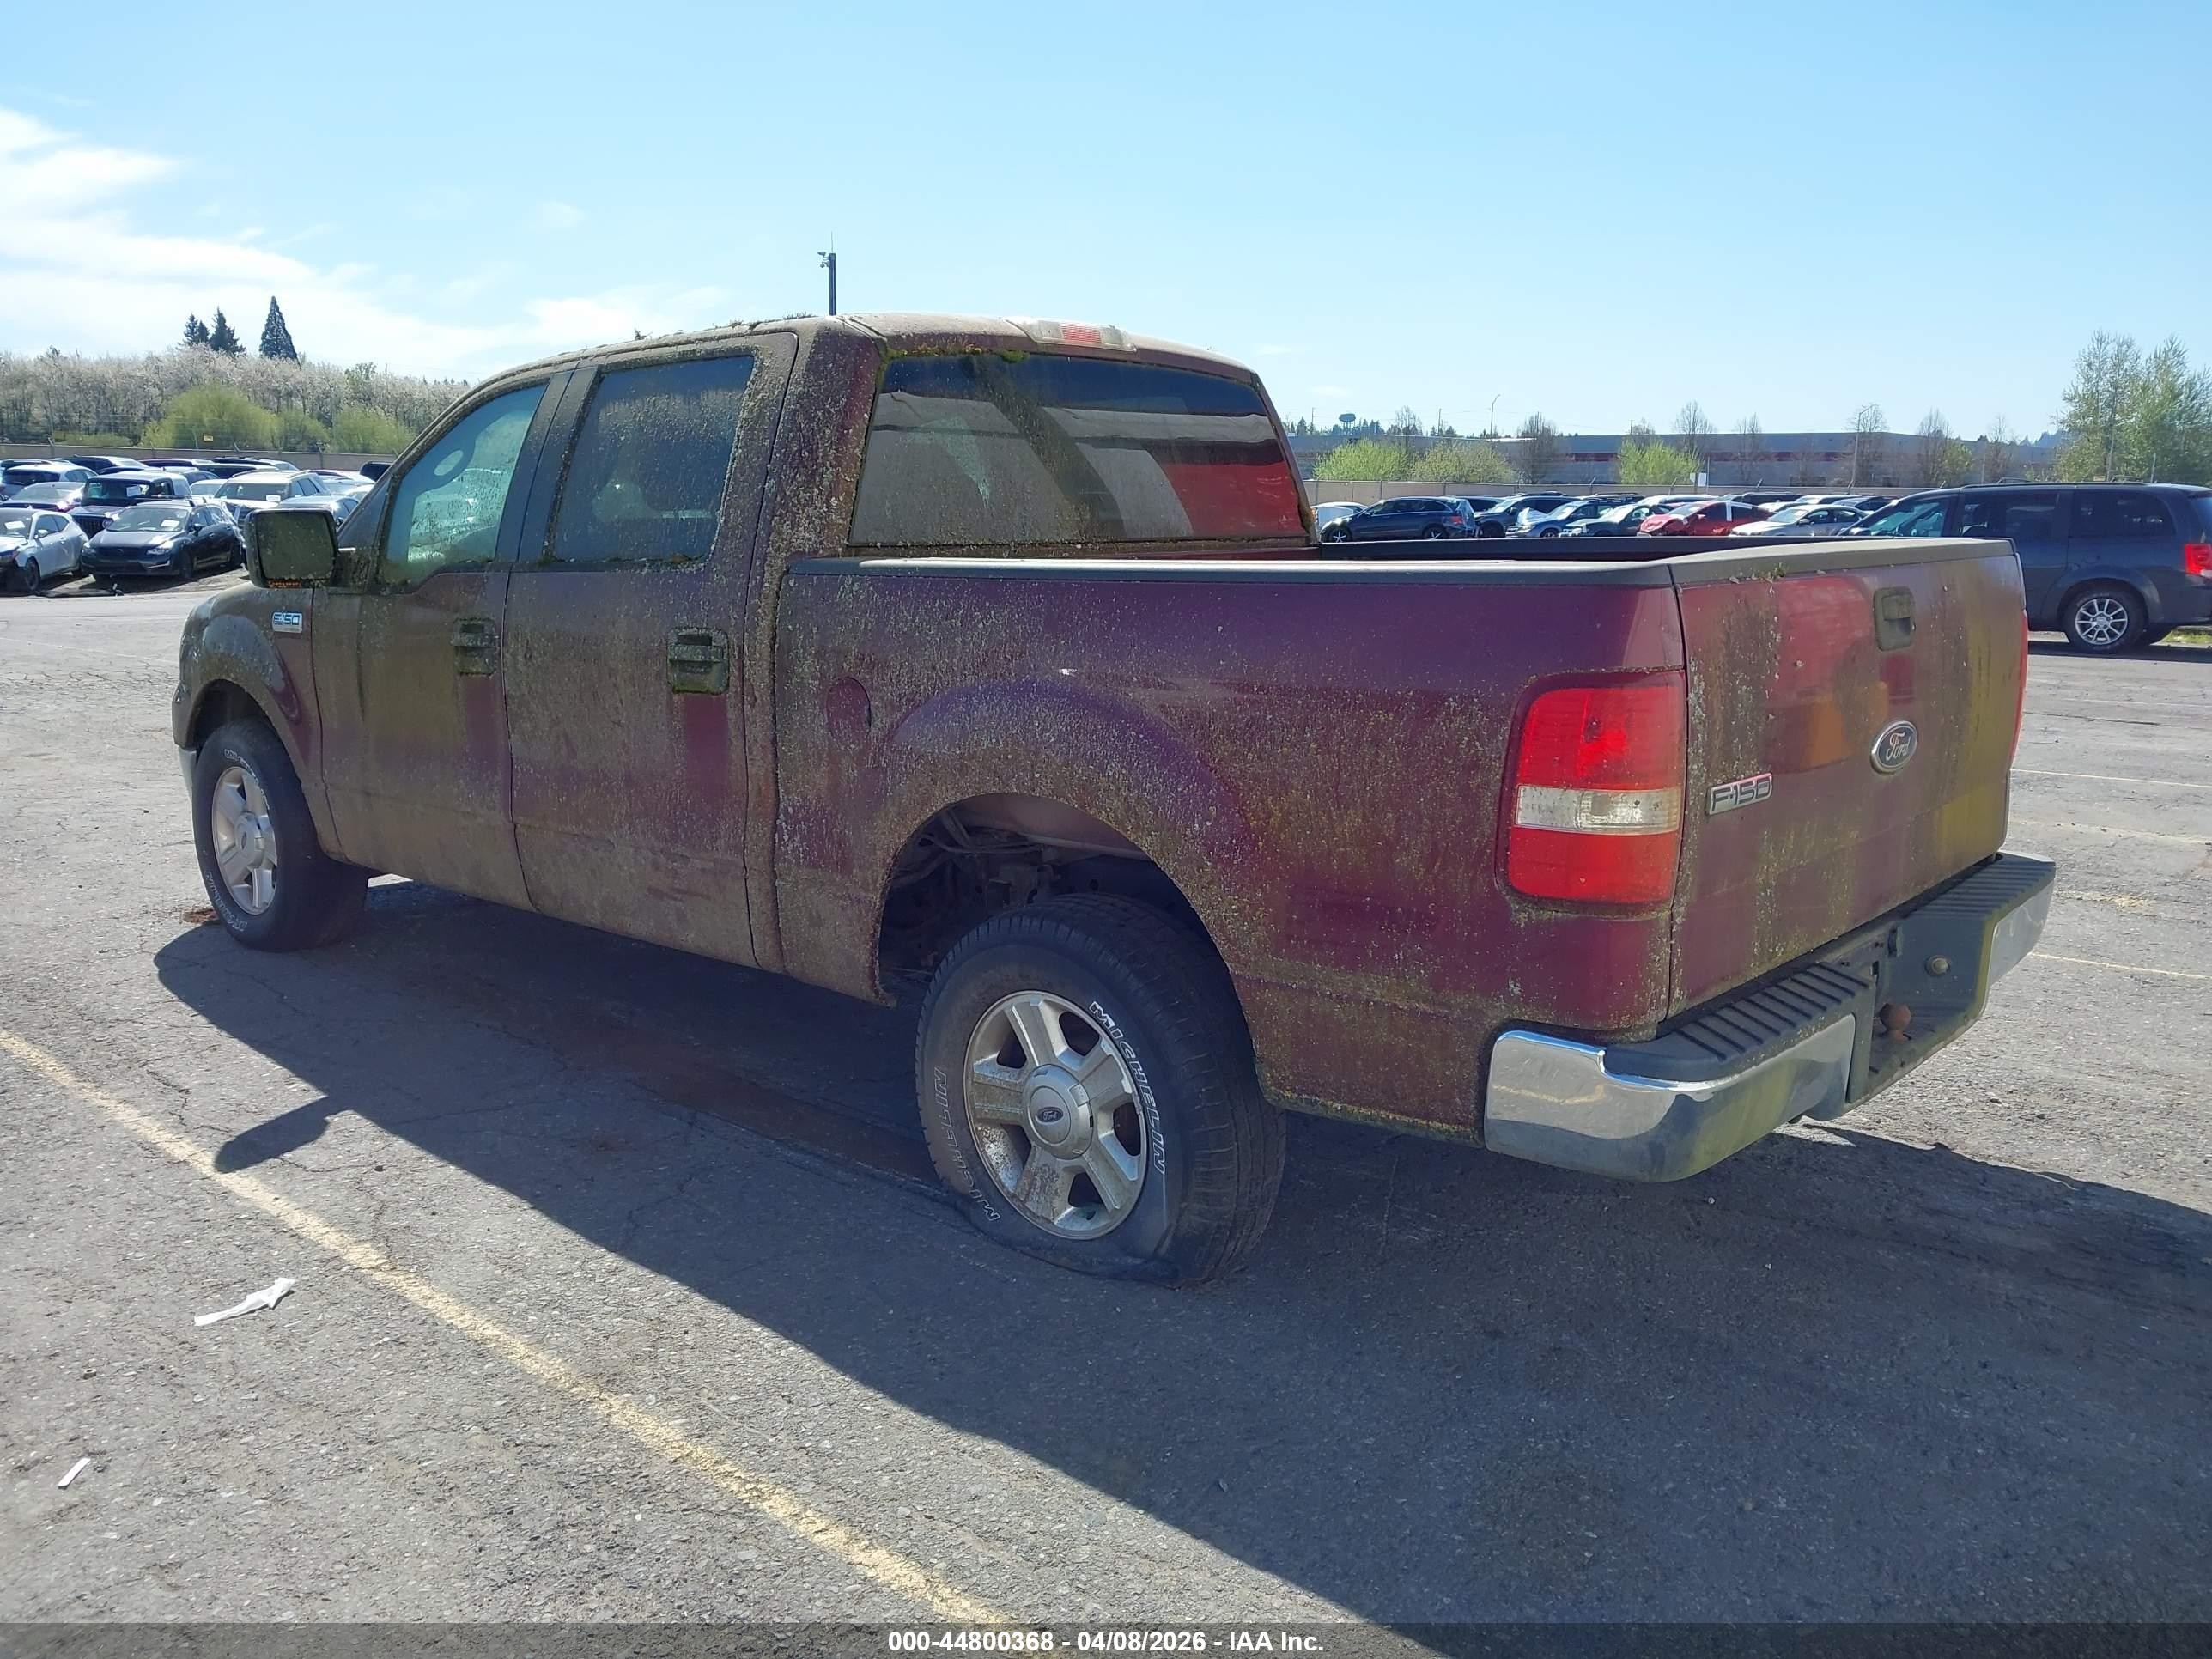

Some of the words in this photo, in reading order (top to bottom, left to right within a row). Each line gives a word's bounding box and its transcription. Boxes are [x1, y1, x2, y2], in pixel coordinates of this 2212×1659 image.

[1711, 775, 1771, 812] F-150
[1885, 732, 1911, 762] Ford
[1089, 1001, 1166, 1175] MICHELIN
[934, 1066, 1001, 1221] MICHELIN
